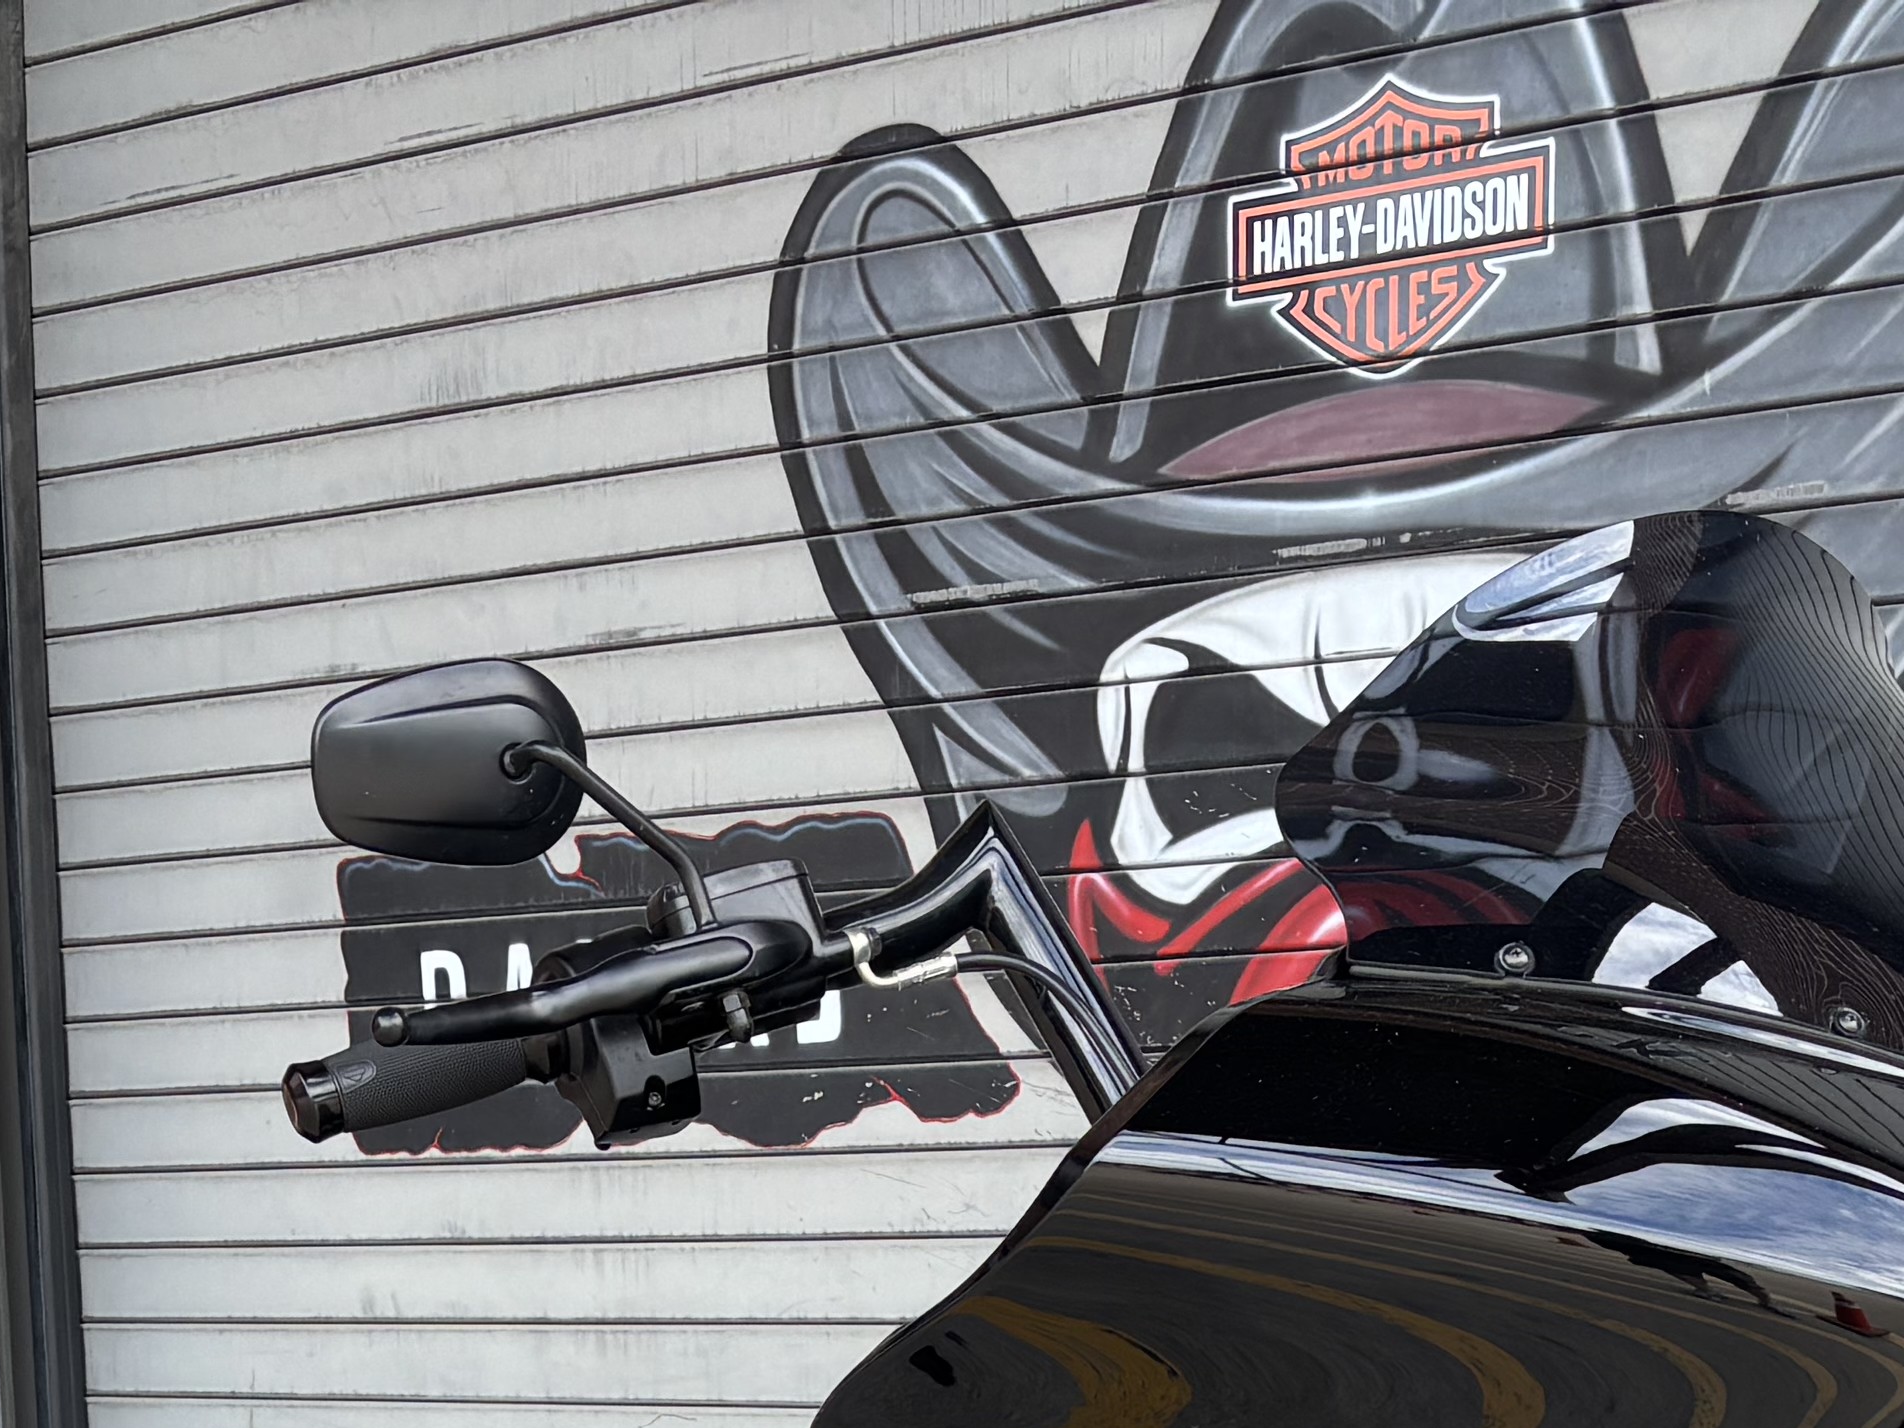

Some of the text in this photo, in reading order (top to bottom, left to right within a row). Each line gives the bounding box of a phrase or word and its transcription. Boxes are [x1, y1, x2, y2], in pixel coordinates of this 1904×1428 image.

[1317, 110, 1463, 188] MOTOR
[1253, 173, 1529, 276] HARLEY-DAVIDSON
[1314, 265, 1458, 350] CYCLES
